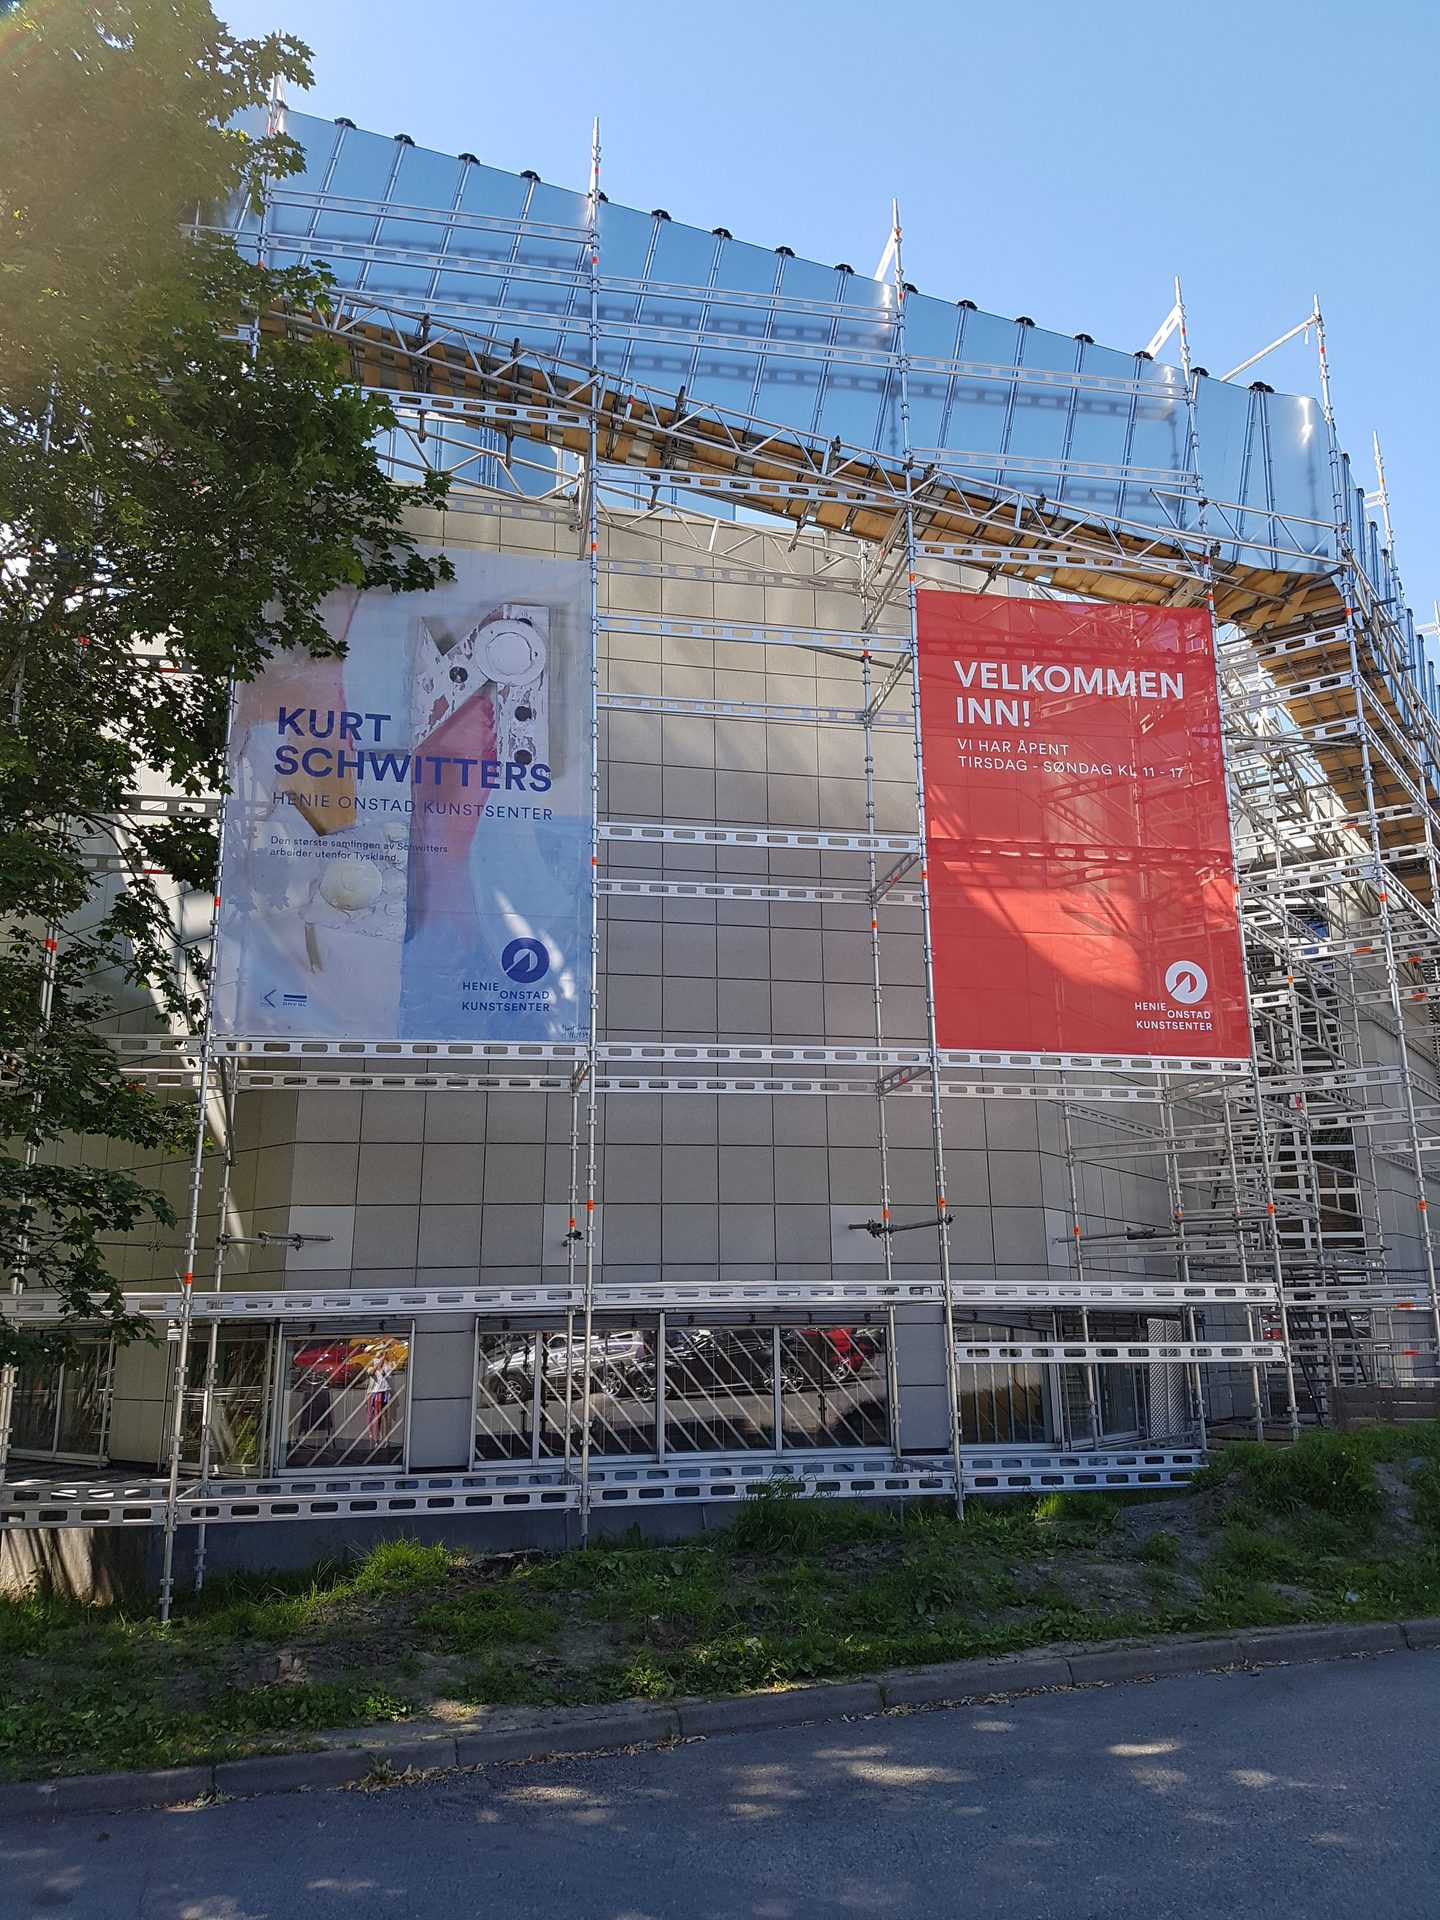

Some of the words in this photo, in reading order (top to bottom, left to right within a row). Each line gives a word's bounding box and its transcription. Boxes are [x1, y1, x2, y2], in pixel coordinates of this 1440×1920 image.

[954, 660, 1183, 699] VELKOMMEN
[957, 697, 1031, 728] INN!
[278, 706, 391, 742] KURT
[957, 738, 972, 750] VI
[978, 740, 1011, 753] HAR
[1017, 739, 1069, 756] ÅPENT
[274, 745, 552, 793] SCHWITTERS
[958, 756, 1027, 771] TIRSDAG
[1043, 761, 1112, 775] SØNDAG
[1143, 767, 1155, 777] 11
[1170, 767, 1183, 778] 17
[273, 791, 330, 809] HENIE
[338, 795, 416, 813] ONSTAD
[423, 800, 553, 822] KUNSTSENTER
[271, 835, 291, 845] Den
[293, 837, 328, 847] største
[330, 839, 380, 851] samlingen
[397, 842, 448, 853] Schwitters
[269, 848, 312, 858] arbeider
[315, 850, 351, 859] utenfor
[354, 851, 400, 862] Tyskland.
[462, 981, 499, 992] HENIE
[499, 990, 550, 1000] ONSTAD
[462, 1001, 550, 1012] KUNSTSENTER
[1134, 1002, 1167, 1011] HENIE
[1167, 1009, 1211, 1020] ONSTAD
[1136, 1020, 1213, 1031] KUNSTSENTER
